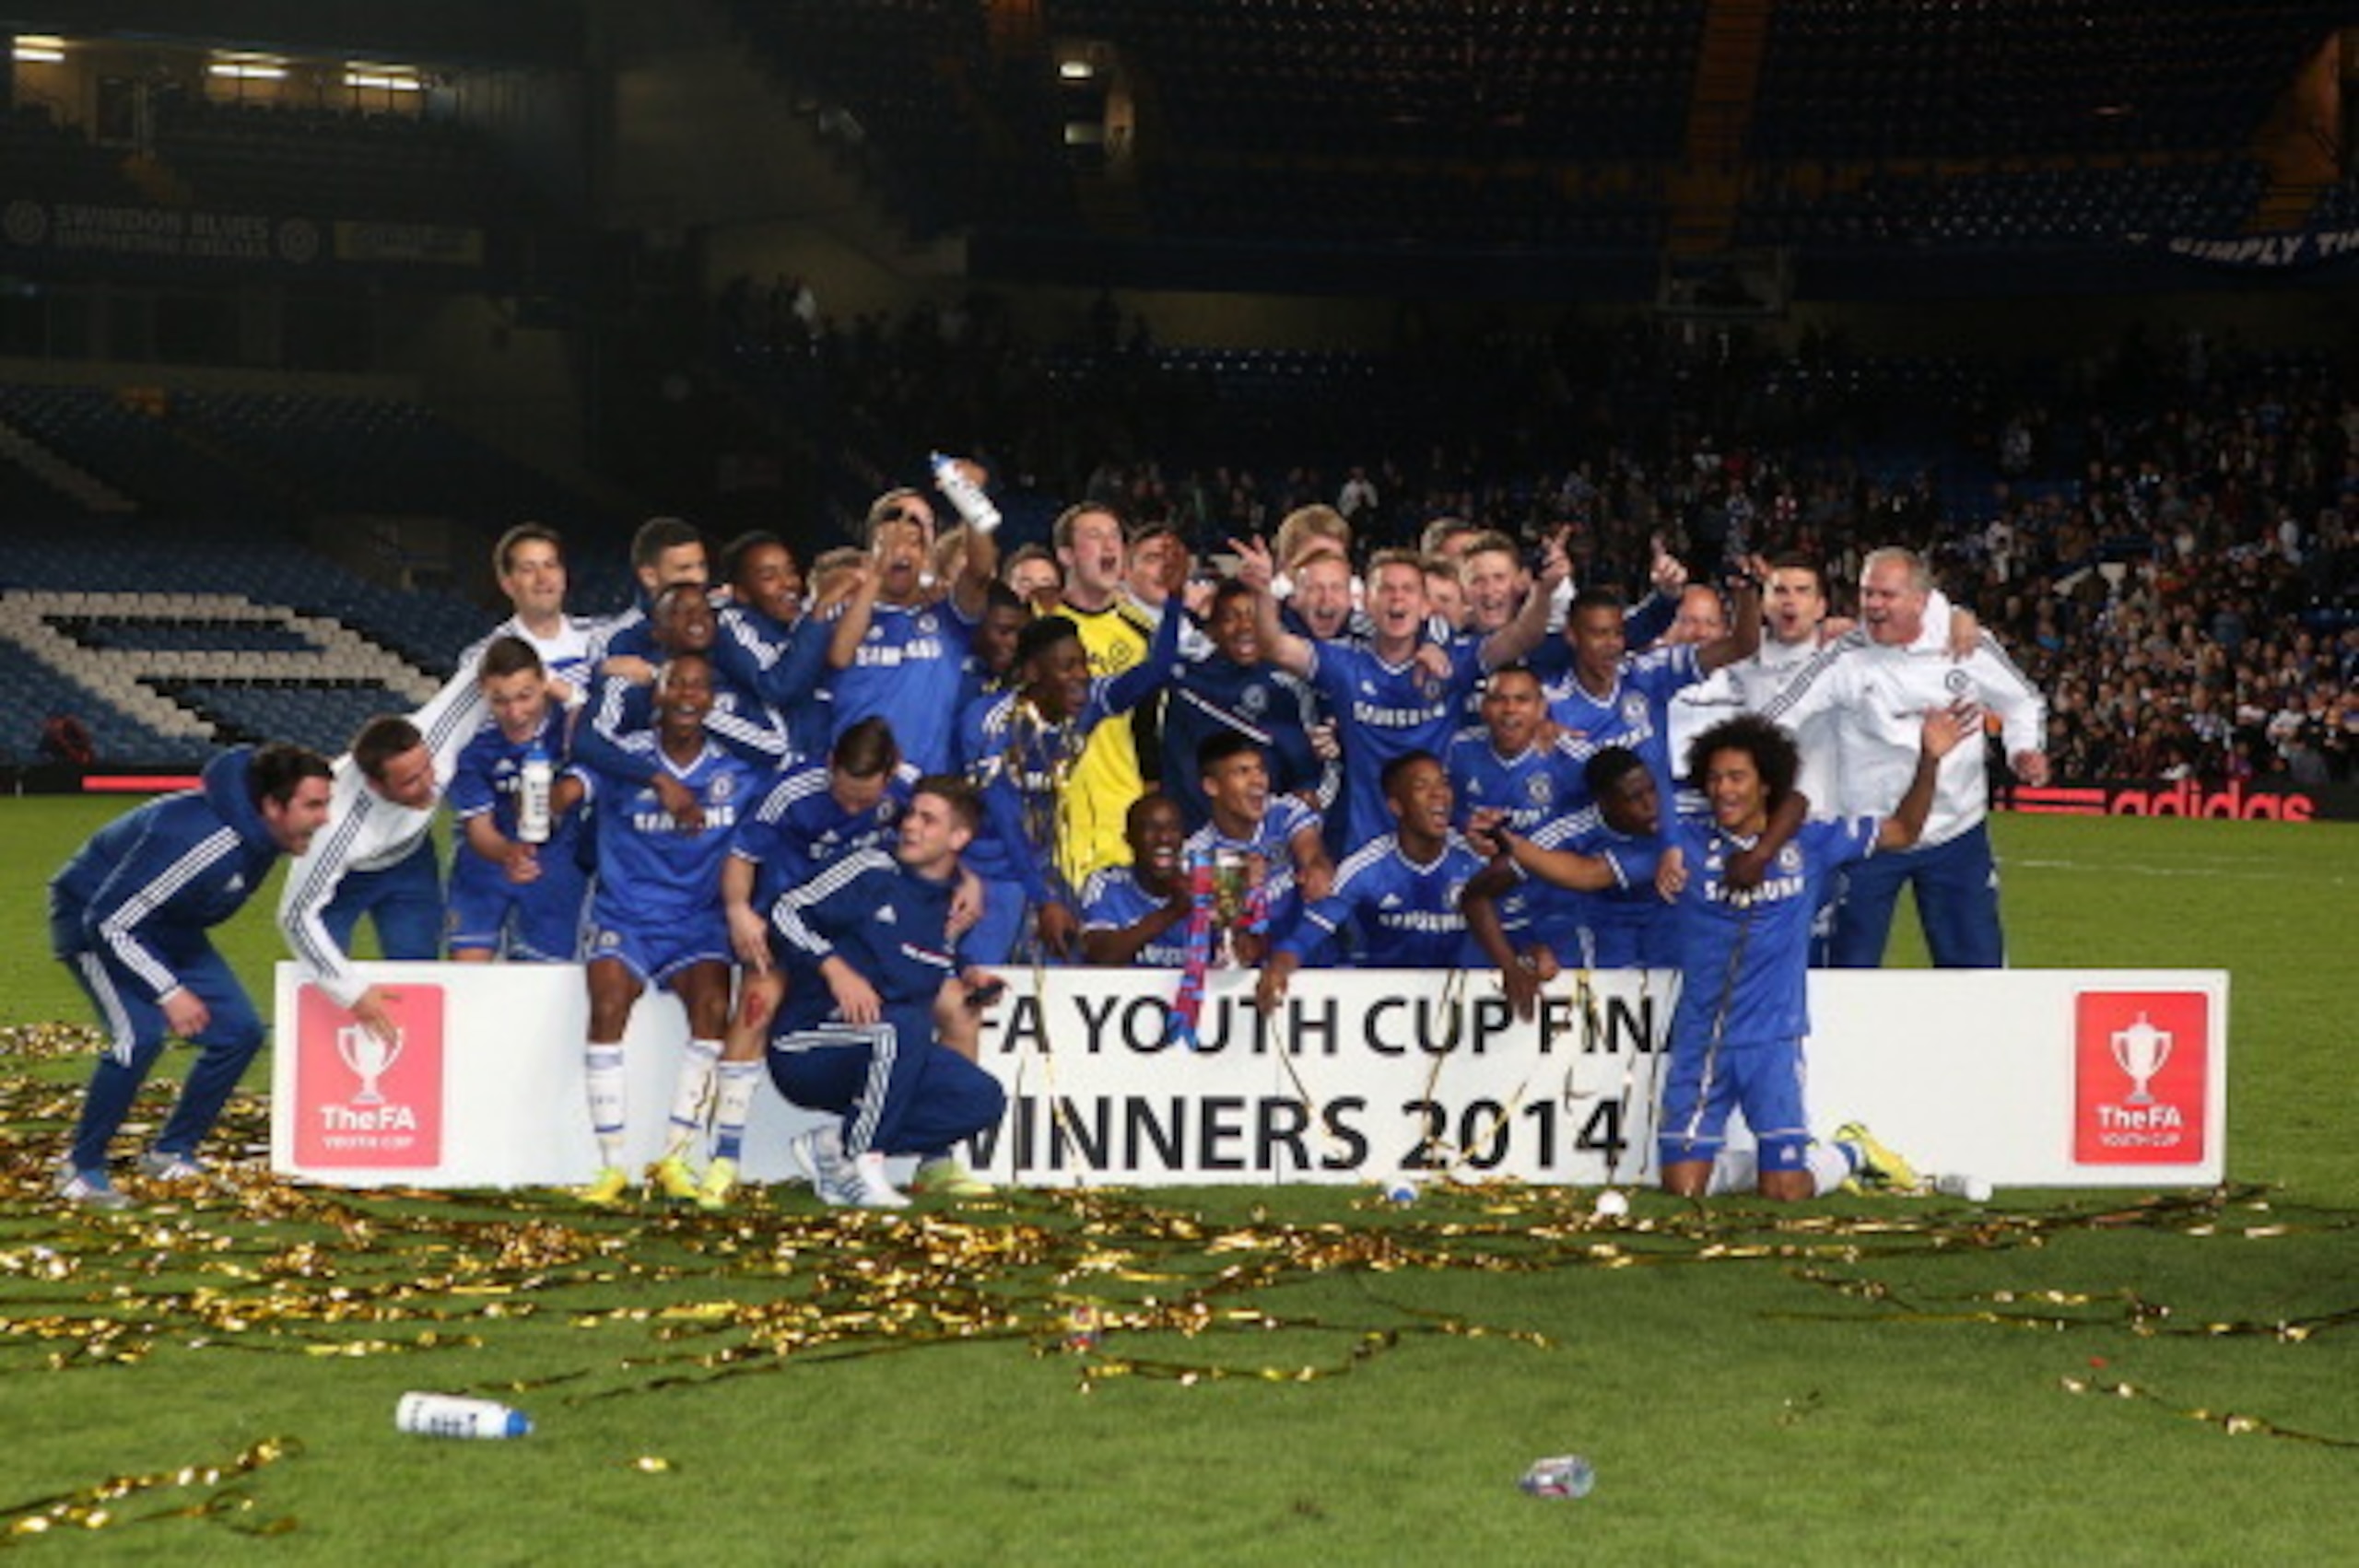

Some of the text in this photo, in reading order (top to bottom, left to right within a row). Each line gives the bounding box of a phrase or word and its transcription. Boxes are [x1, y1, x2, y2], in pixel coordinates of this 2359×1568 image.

[855, 638, 943, 667] SAMUNG
[633, 804, 735, 832] SAMNG
[2110, 779, 2317, 822] adidas
[979, 995, 1671, 1056] A YOUTH CUP FIN
[1399, 1099, 1627, 1170] 2014
